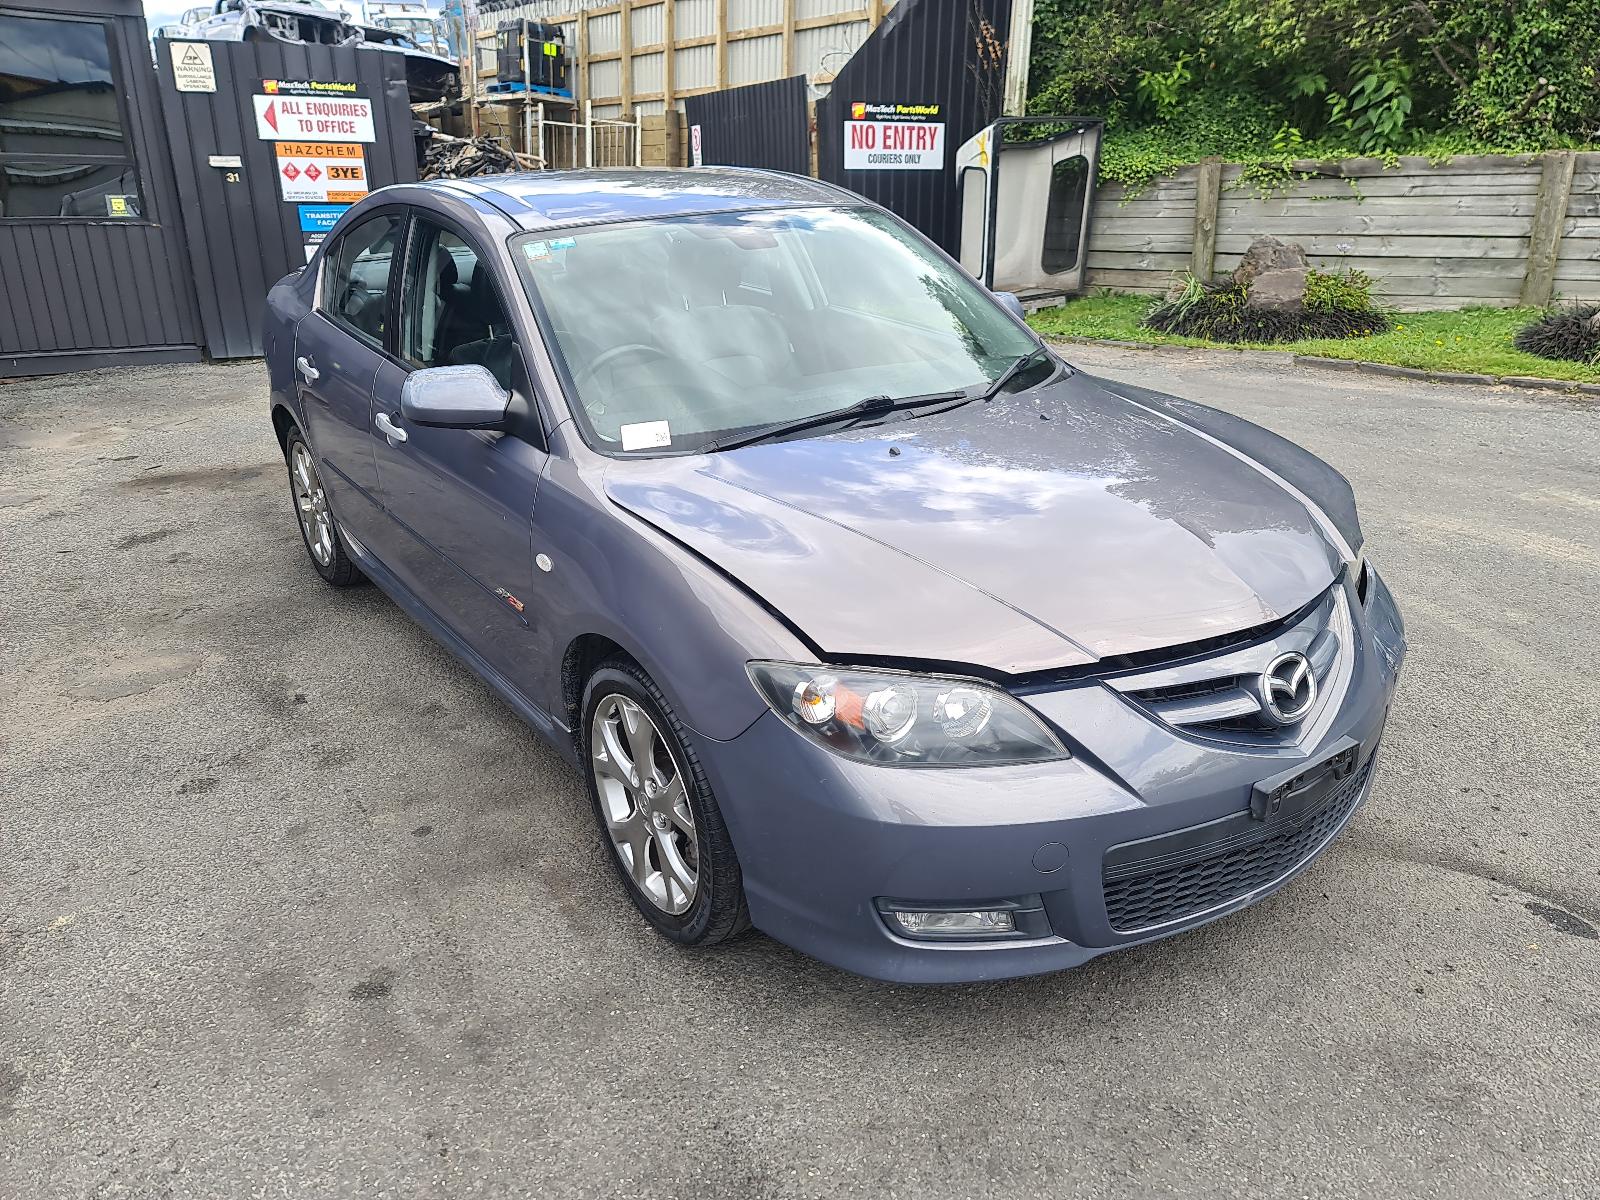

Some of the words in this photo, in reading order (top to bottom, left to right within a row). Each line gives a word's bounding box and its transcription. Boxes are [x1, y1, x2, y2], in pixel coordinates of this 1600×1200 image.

[281, 101, 303, 115] ALL
[306, 102, 368, 117] ENQUIRIES
[896, 104, 940, 115] PartsWorld
[298, 119, 313, 133] TO
[317, 120, 357, 134] OFFICE
[851, 124, 876, 150] NO
[882, 125, 938, 151] ENTRY
[284, 144, 356, 156] HAZCHEM
[867, 153, 903, 164] COURIERS
[904, 154, 922, 164] ONLY
[225, 172, 241, 183] 31
[330, 167, 359, 179] 3YE
